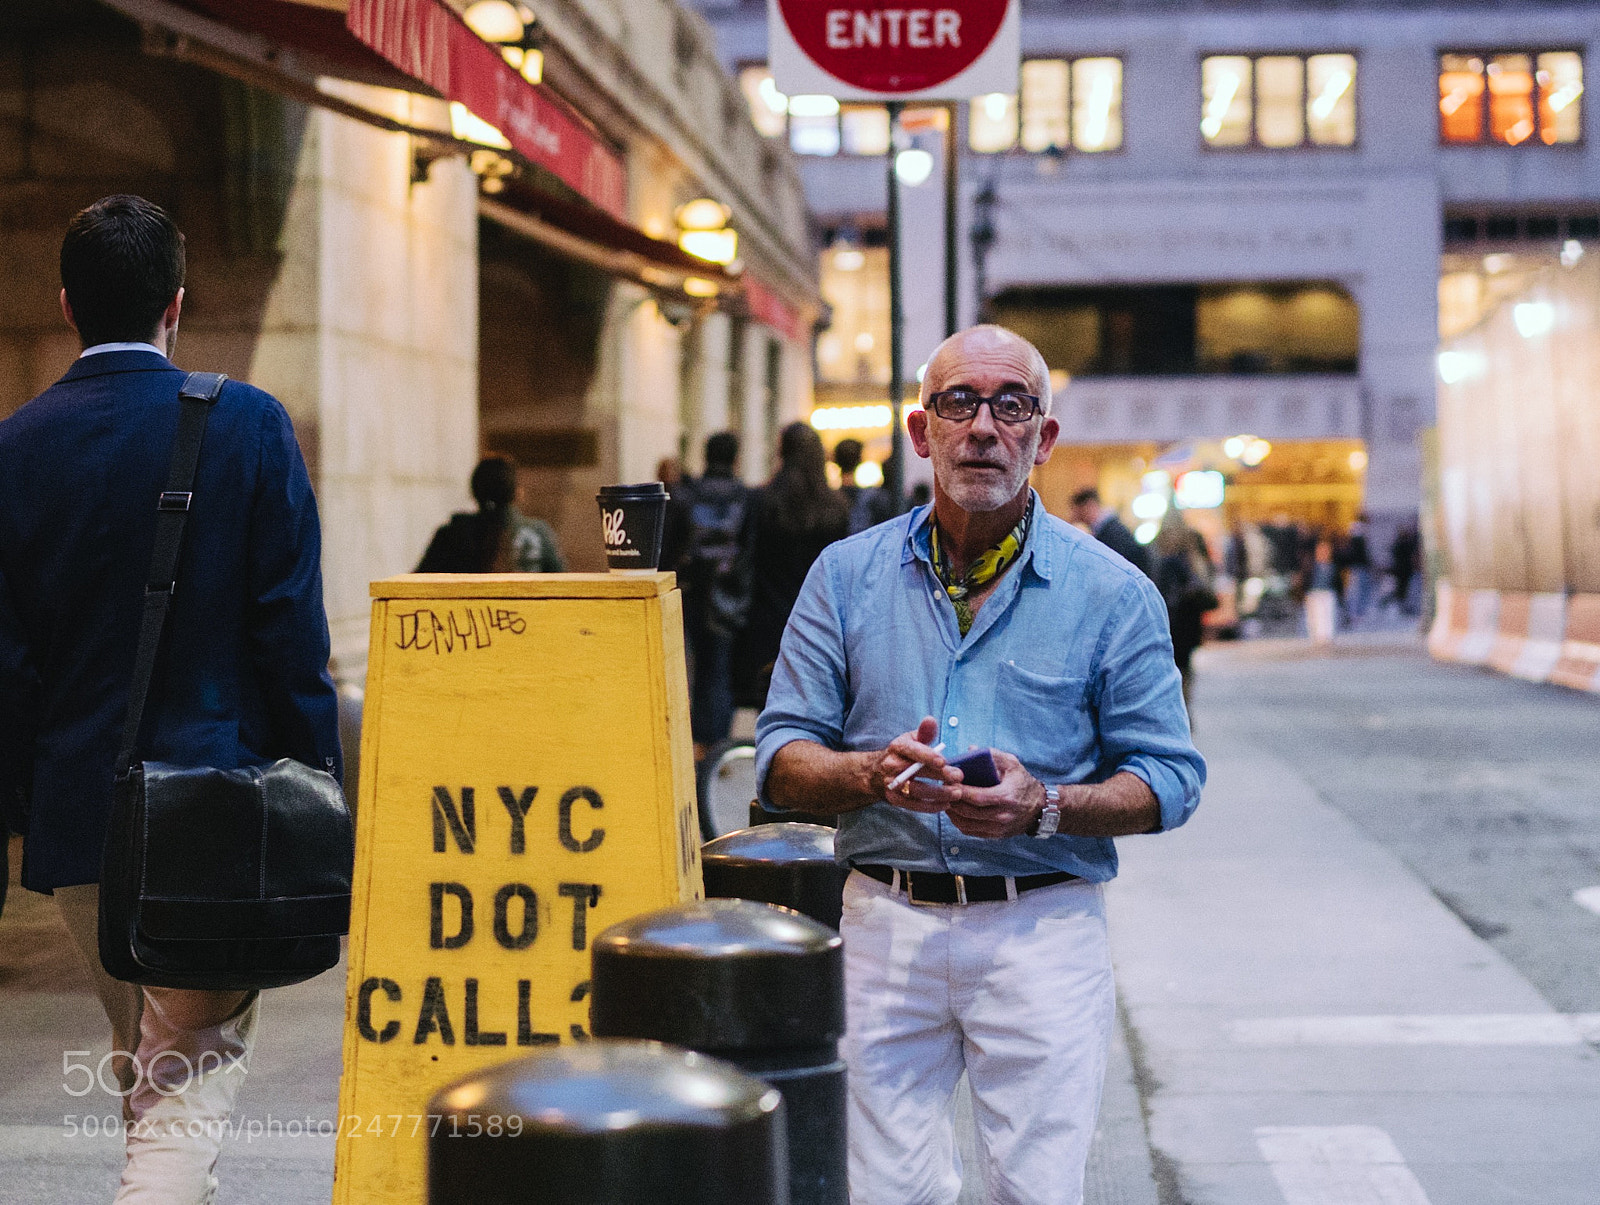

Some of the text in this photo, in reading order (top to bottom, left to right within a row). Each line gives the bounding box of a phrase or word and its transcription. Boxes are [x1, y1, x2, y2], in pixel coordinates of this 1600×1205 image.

[825, 8, 962, 49] ENTER
[431, 785, 606, 855] NYC
[429, 881, 602, 951] DOT
